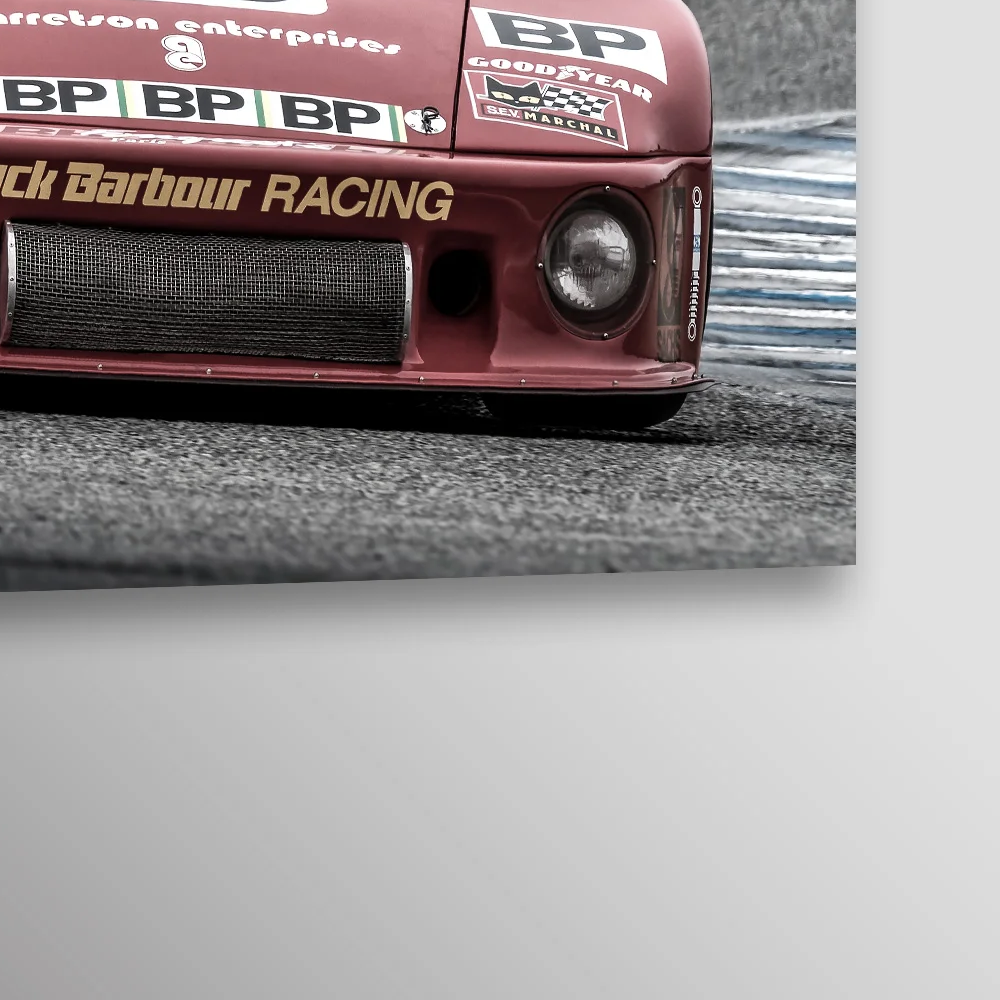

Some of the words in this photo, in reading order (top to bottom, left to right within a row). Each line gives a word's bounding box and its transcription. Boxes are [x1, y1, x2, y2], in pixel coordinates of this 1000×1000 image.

[174, 18, 402, 55] enterprises
[488, 12, 647, 58] BP
[467, 57, 653, 104] GOODYEAR
[2, 79, 108, 113] BP
[141, 84, 245, 121] BP
[280, 95, 381, 134] BP
[523, 111, 617, 139] MARCHAL
[63, 161, 251, 212] Barbour
[261, 174, 455, 221] RACING
